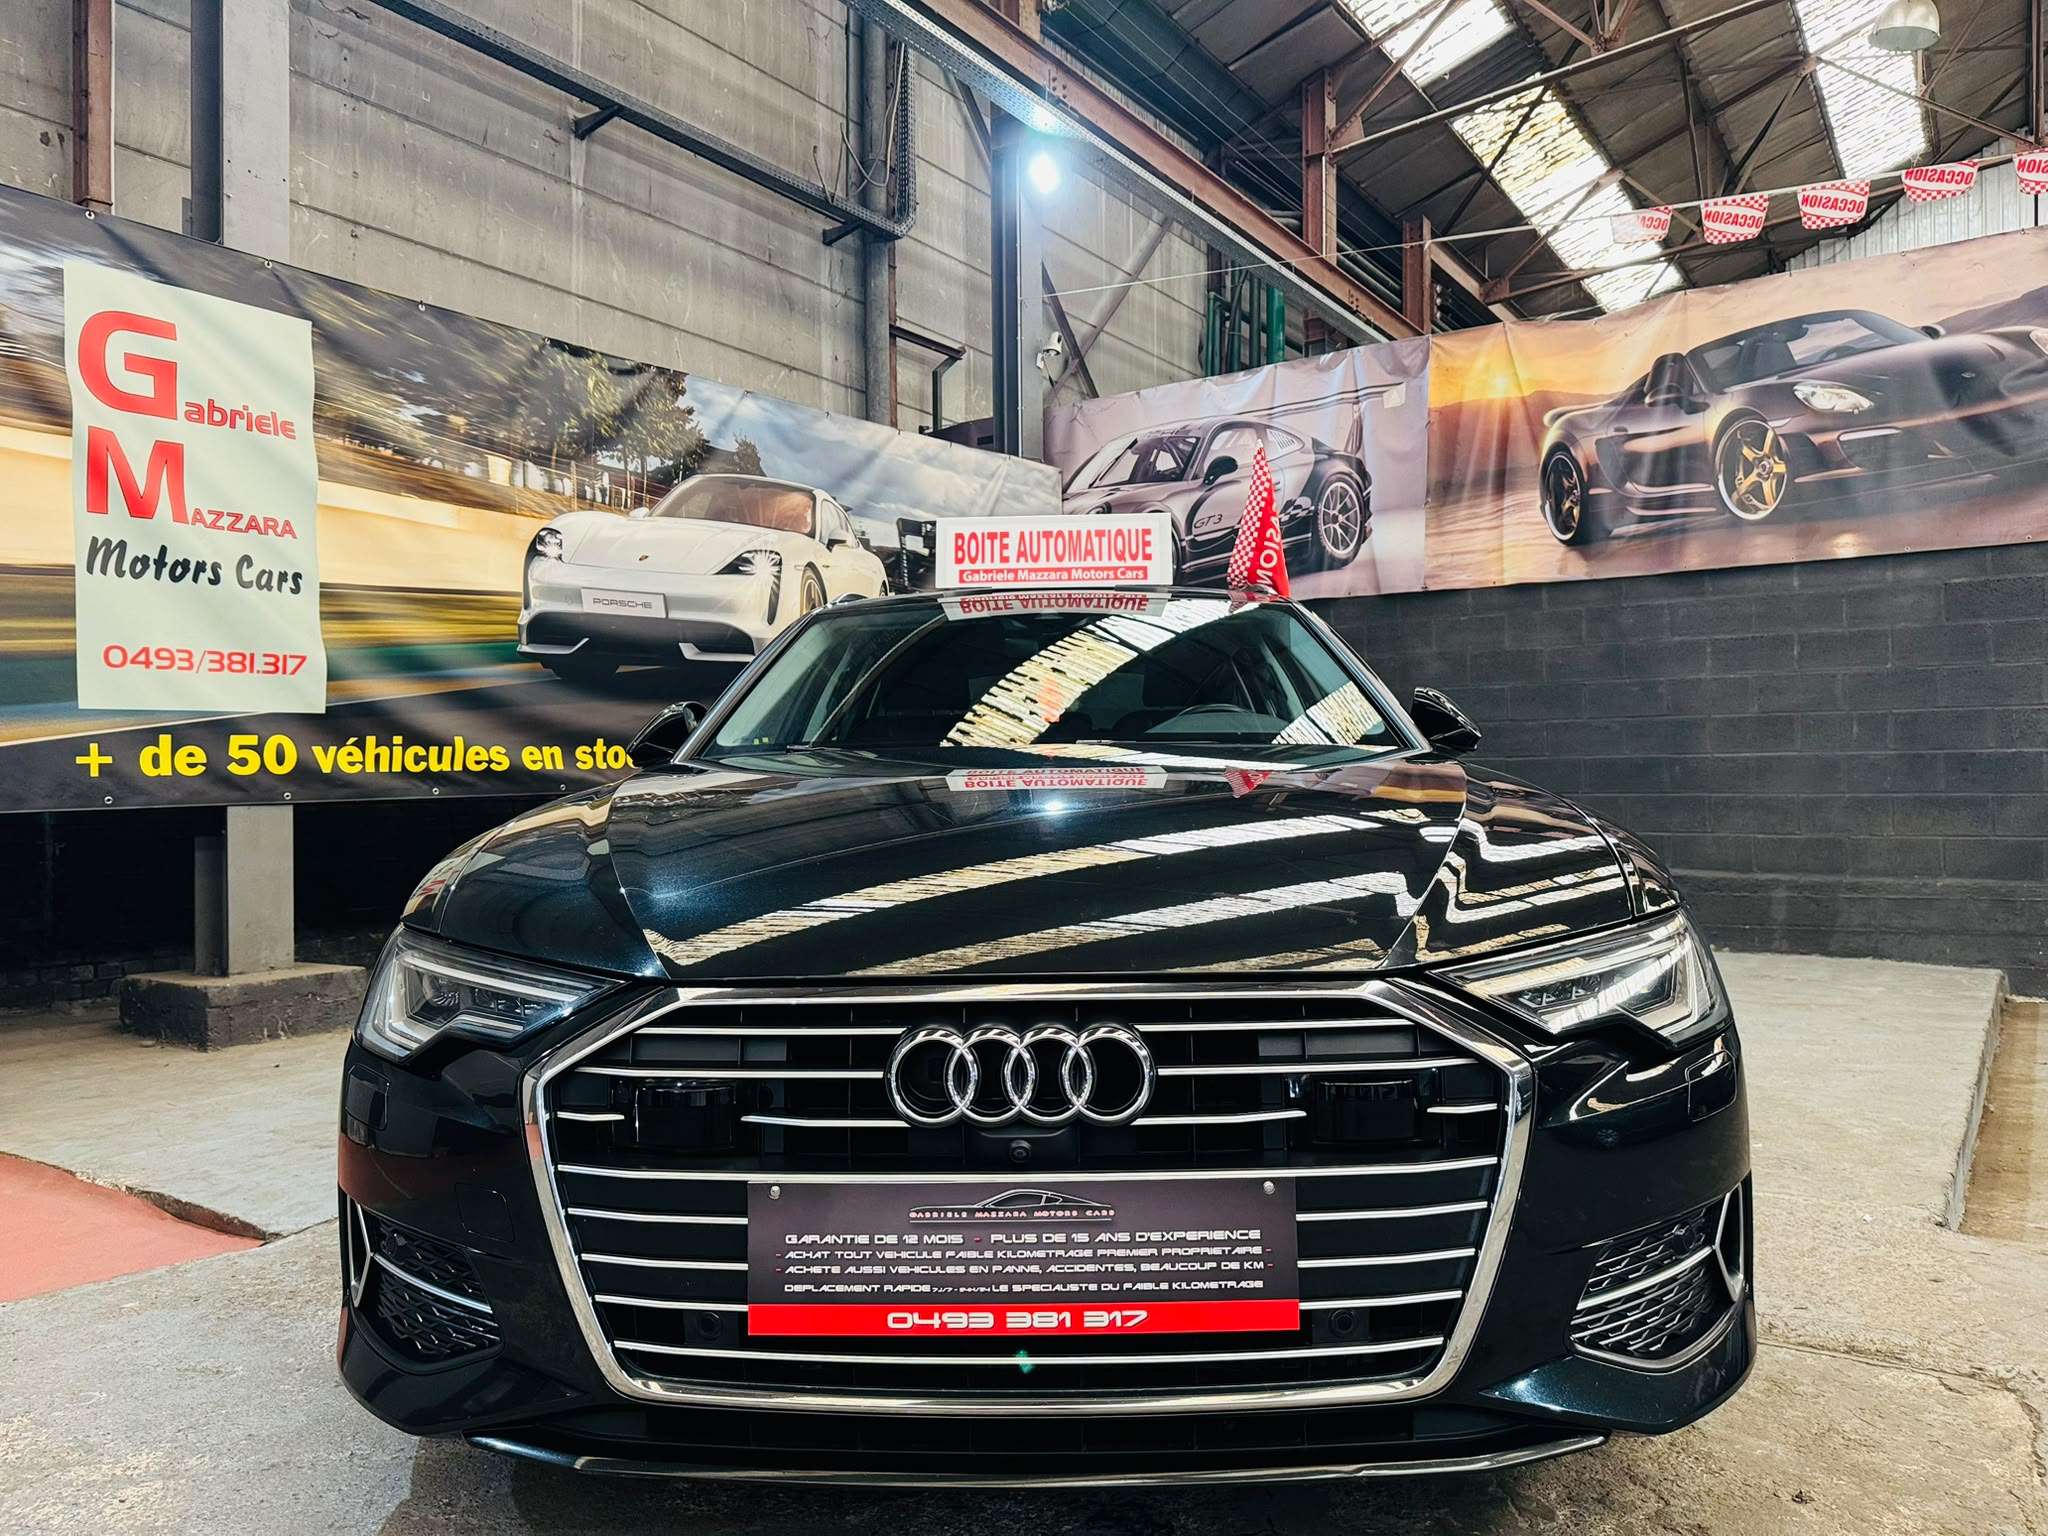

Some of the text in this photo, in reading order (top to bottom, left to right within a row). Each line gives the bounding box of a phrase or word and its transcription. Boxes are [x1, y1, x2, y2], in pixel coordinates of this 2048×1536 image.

[78, 311, 296, 440] Gabriele
[954, 528, 1152, 565] BOITE AUTOMATIQUE
[86, 536, 302, 595] Motors Cars
[963, 567, 1144, 582] Gabriele Mazzara Motors Cars
[592, 597, 653, 609] PORSCHE
[103, 645, 307, 675] 0493/381.317
[139, 734, 207, 776] de
[226, 734, 297, 775] 50
[312, 736, 510, 773] véhicules
[521, 744, 564, 770] en
[575, 738, 635, 769] sto
[785, 1230, 1261, 1245] GARANTIE DE 12 MOIS PLUS DE 15 ANS D'EXPERIENCE
[785, 1247, 1262, 1259] ACHAT TOUT VEHICULE FAIBLE KILOMETRAGE PREMIER PROPRIETAIRE
[785, 1261, 1264, 1274] ACHETE AUSSI VEHICULES EN PANNE, ACCIDENTES, BEAUCOUP DE KM
[784, 1284, 880, 1292] DEPLACEMENT
[884, 1284, 931, 1292] RAPIDE
[992, 1284, 1009, 1292] LE
[1101, 1283, 1119, 1291] DU
[1123, 1282, 1169, 1291] FAIBLE
[1172, 1281, 1263, 1290] KILOMETRAGE
[887, 1310, 1148, 1329] 0493 381 317
